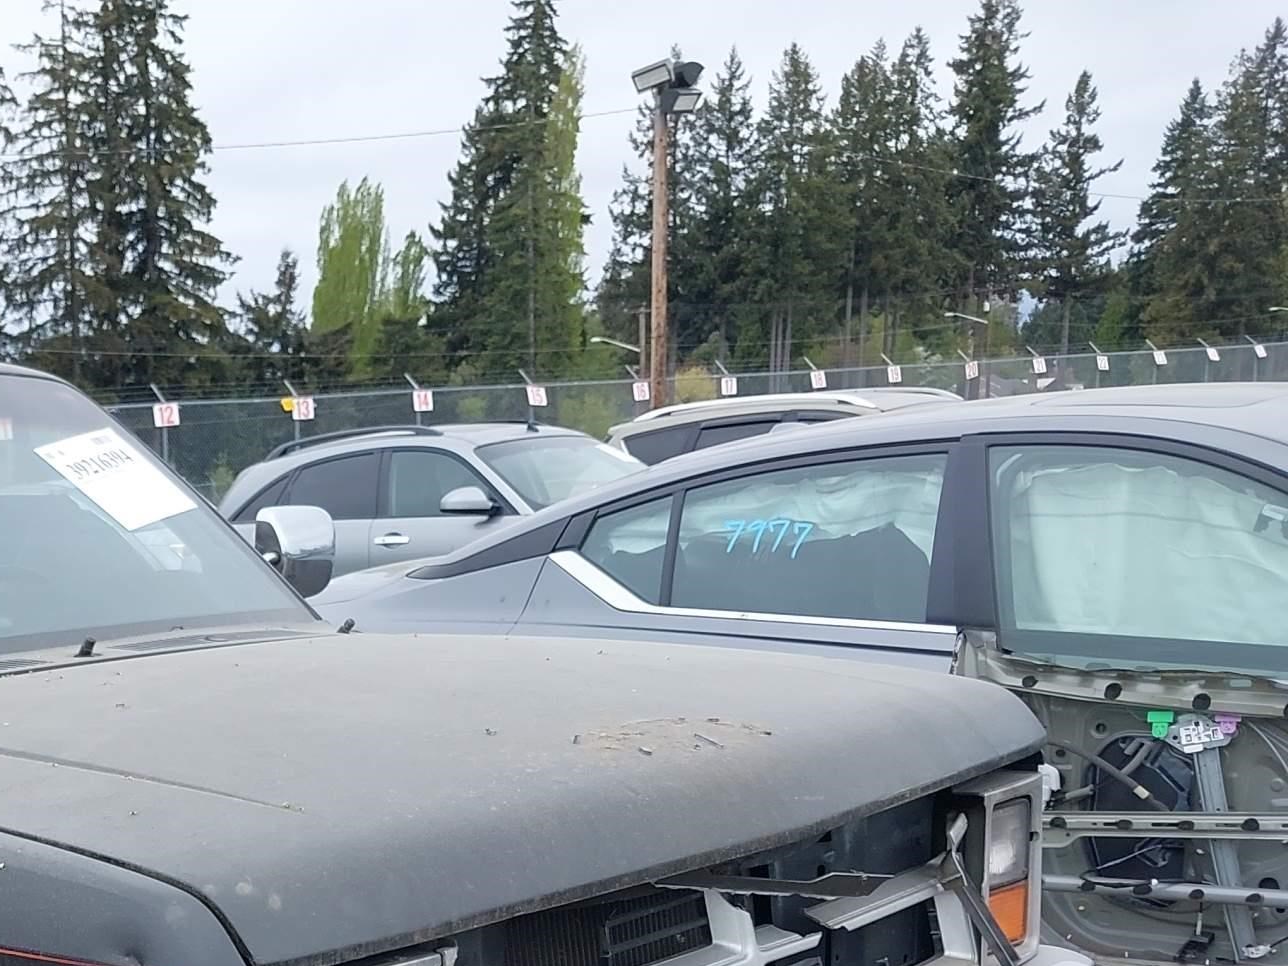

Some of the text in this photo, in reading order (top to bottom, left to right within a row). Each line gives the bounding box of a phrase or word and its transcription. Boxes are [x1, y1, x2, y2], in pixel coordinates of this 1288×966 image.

[530, 389, 544, 404] 15
[636, 383, 647, 399] 16
[416, 392, 429, 408] 14
[157, 406, 175, 424] 12
[295, 400, 310, 418] 13
[723, 519, 814, 559] 7977
